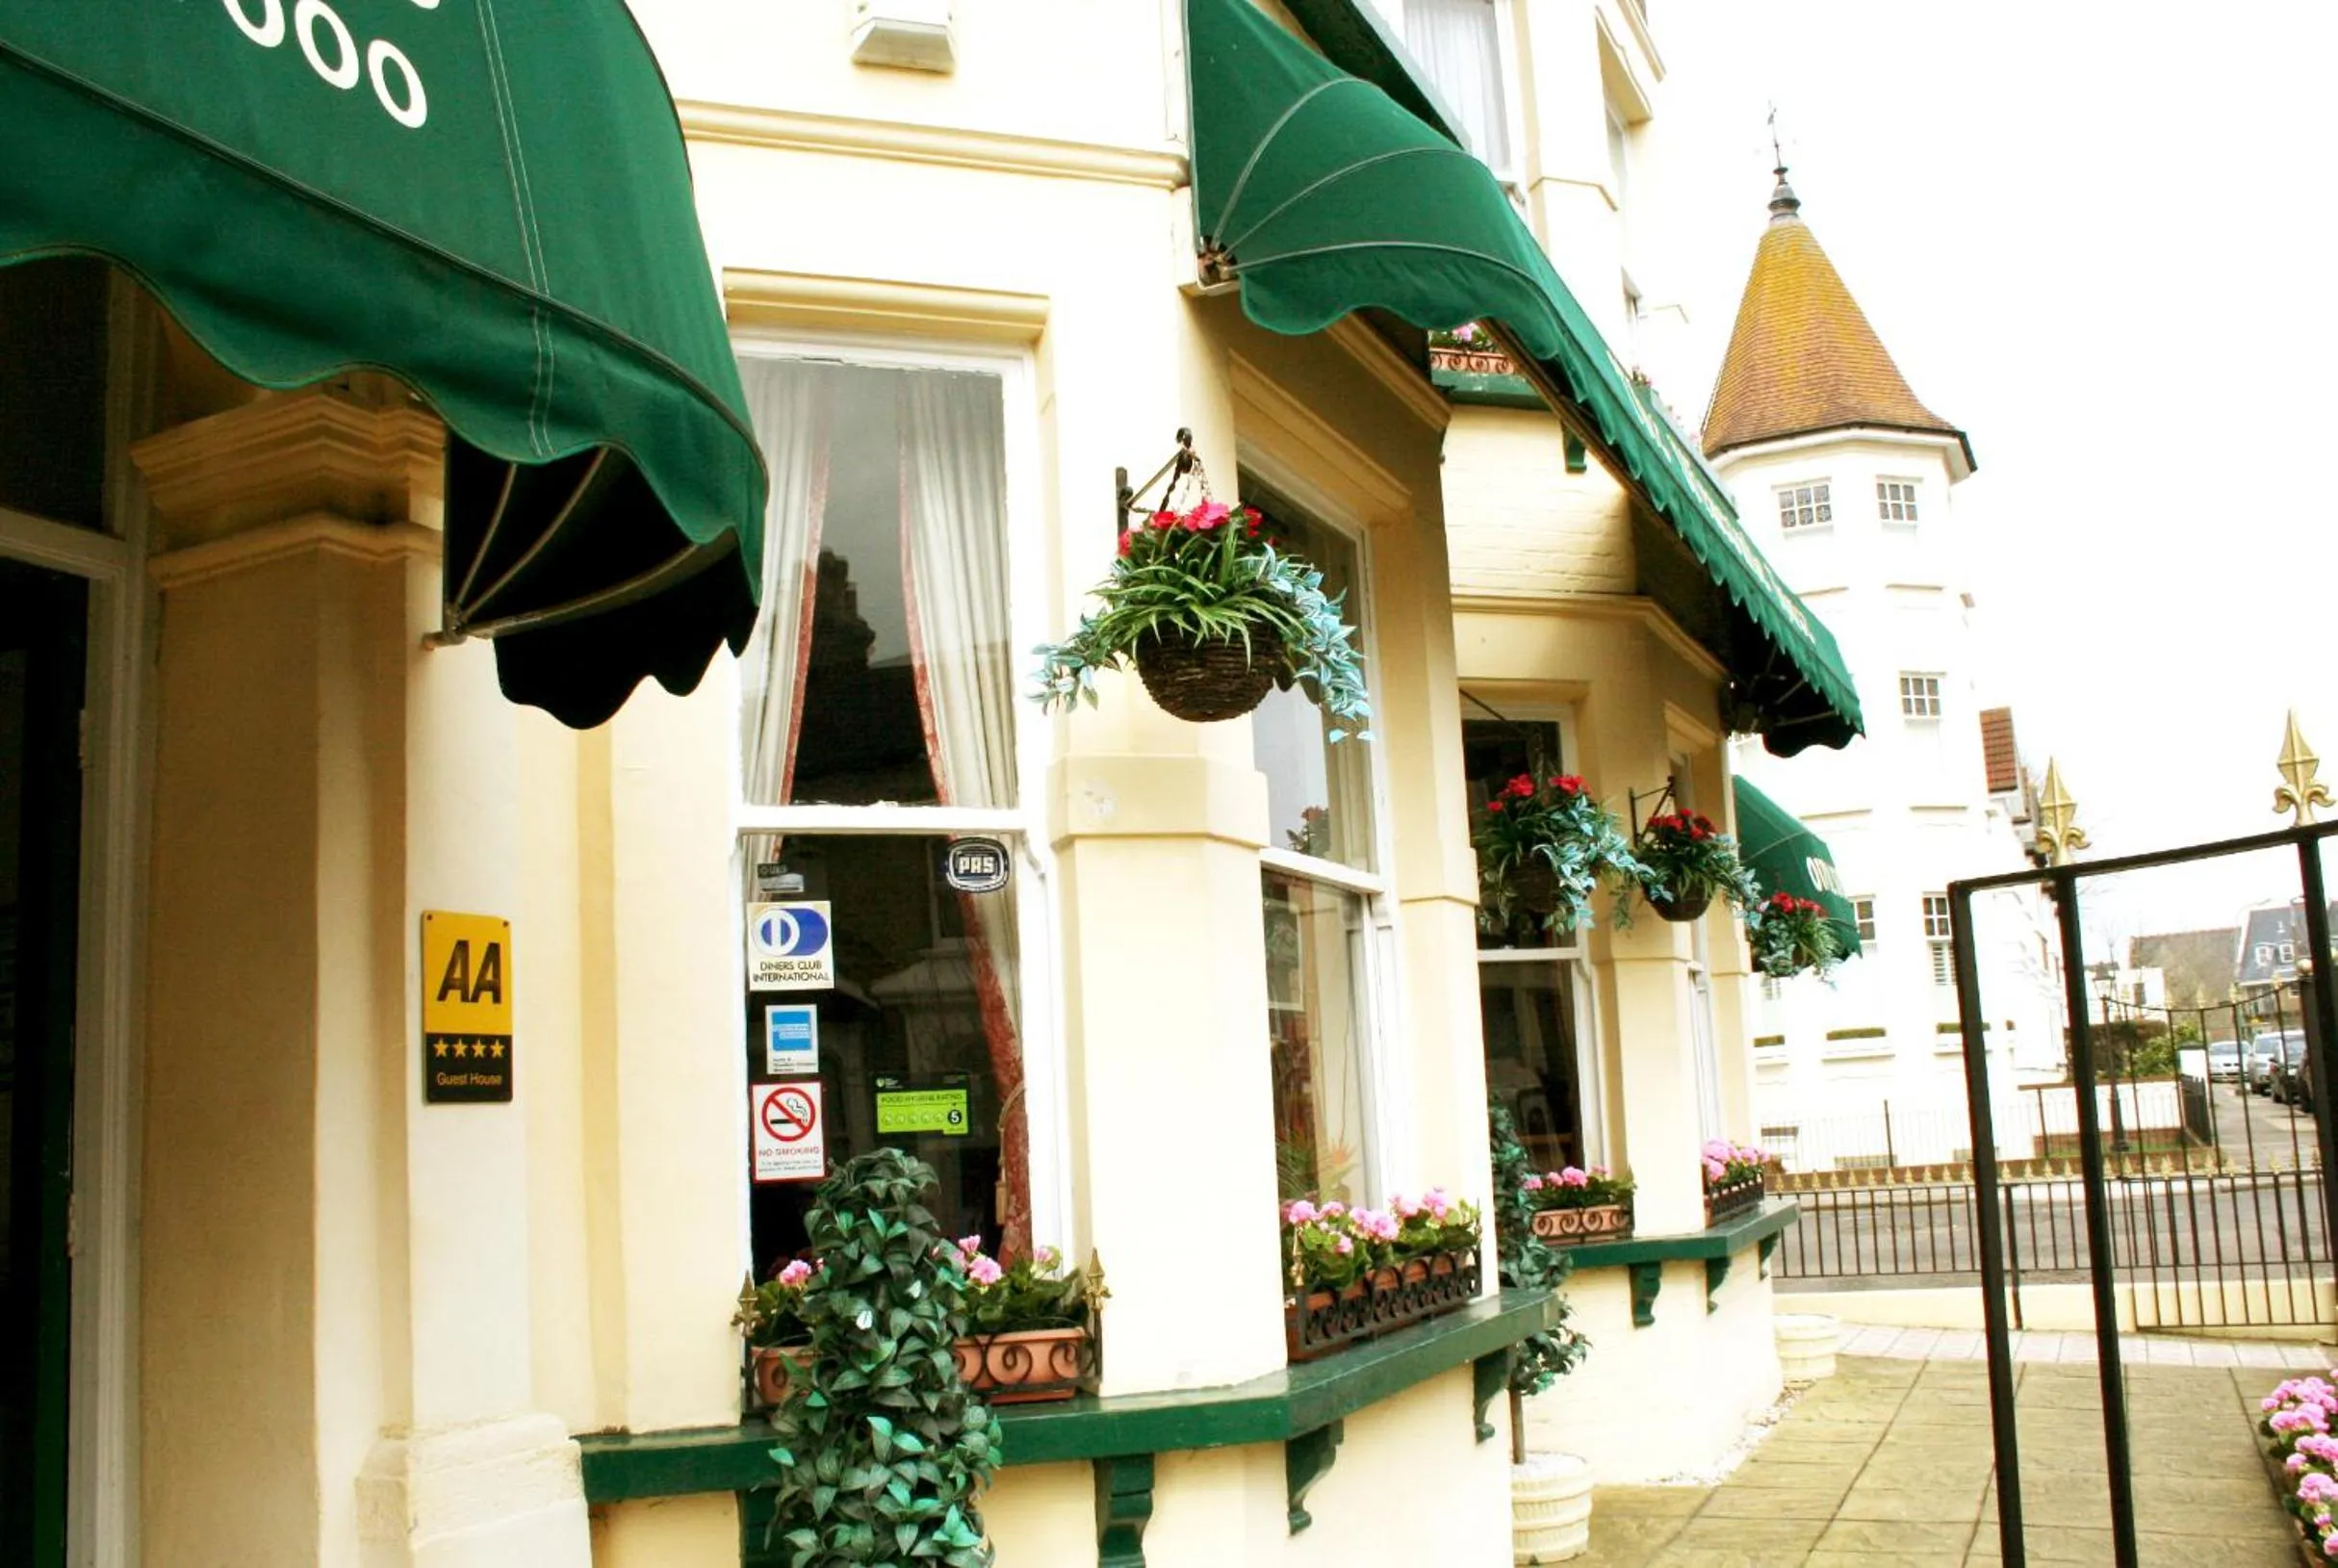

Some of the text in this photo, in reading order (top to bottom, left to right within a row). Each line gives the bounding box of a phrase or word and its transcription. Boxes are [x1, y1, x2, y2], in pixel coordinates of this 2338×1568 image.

[759, 960, 823, 971] DINERS CLUB
[436, 939, 502, 1005] AA
[753, 971, 830, 983] INTERNATIONAL
[437, 1071, 502, 1086] Guest House
[950, 1110, 960, 1123] 5
[758, 1145, 821, 1157] NO SMOKING
